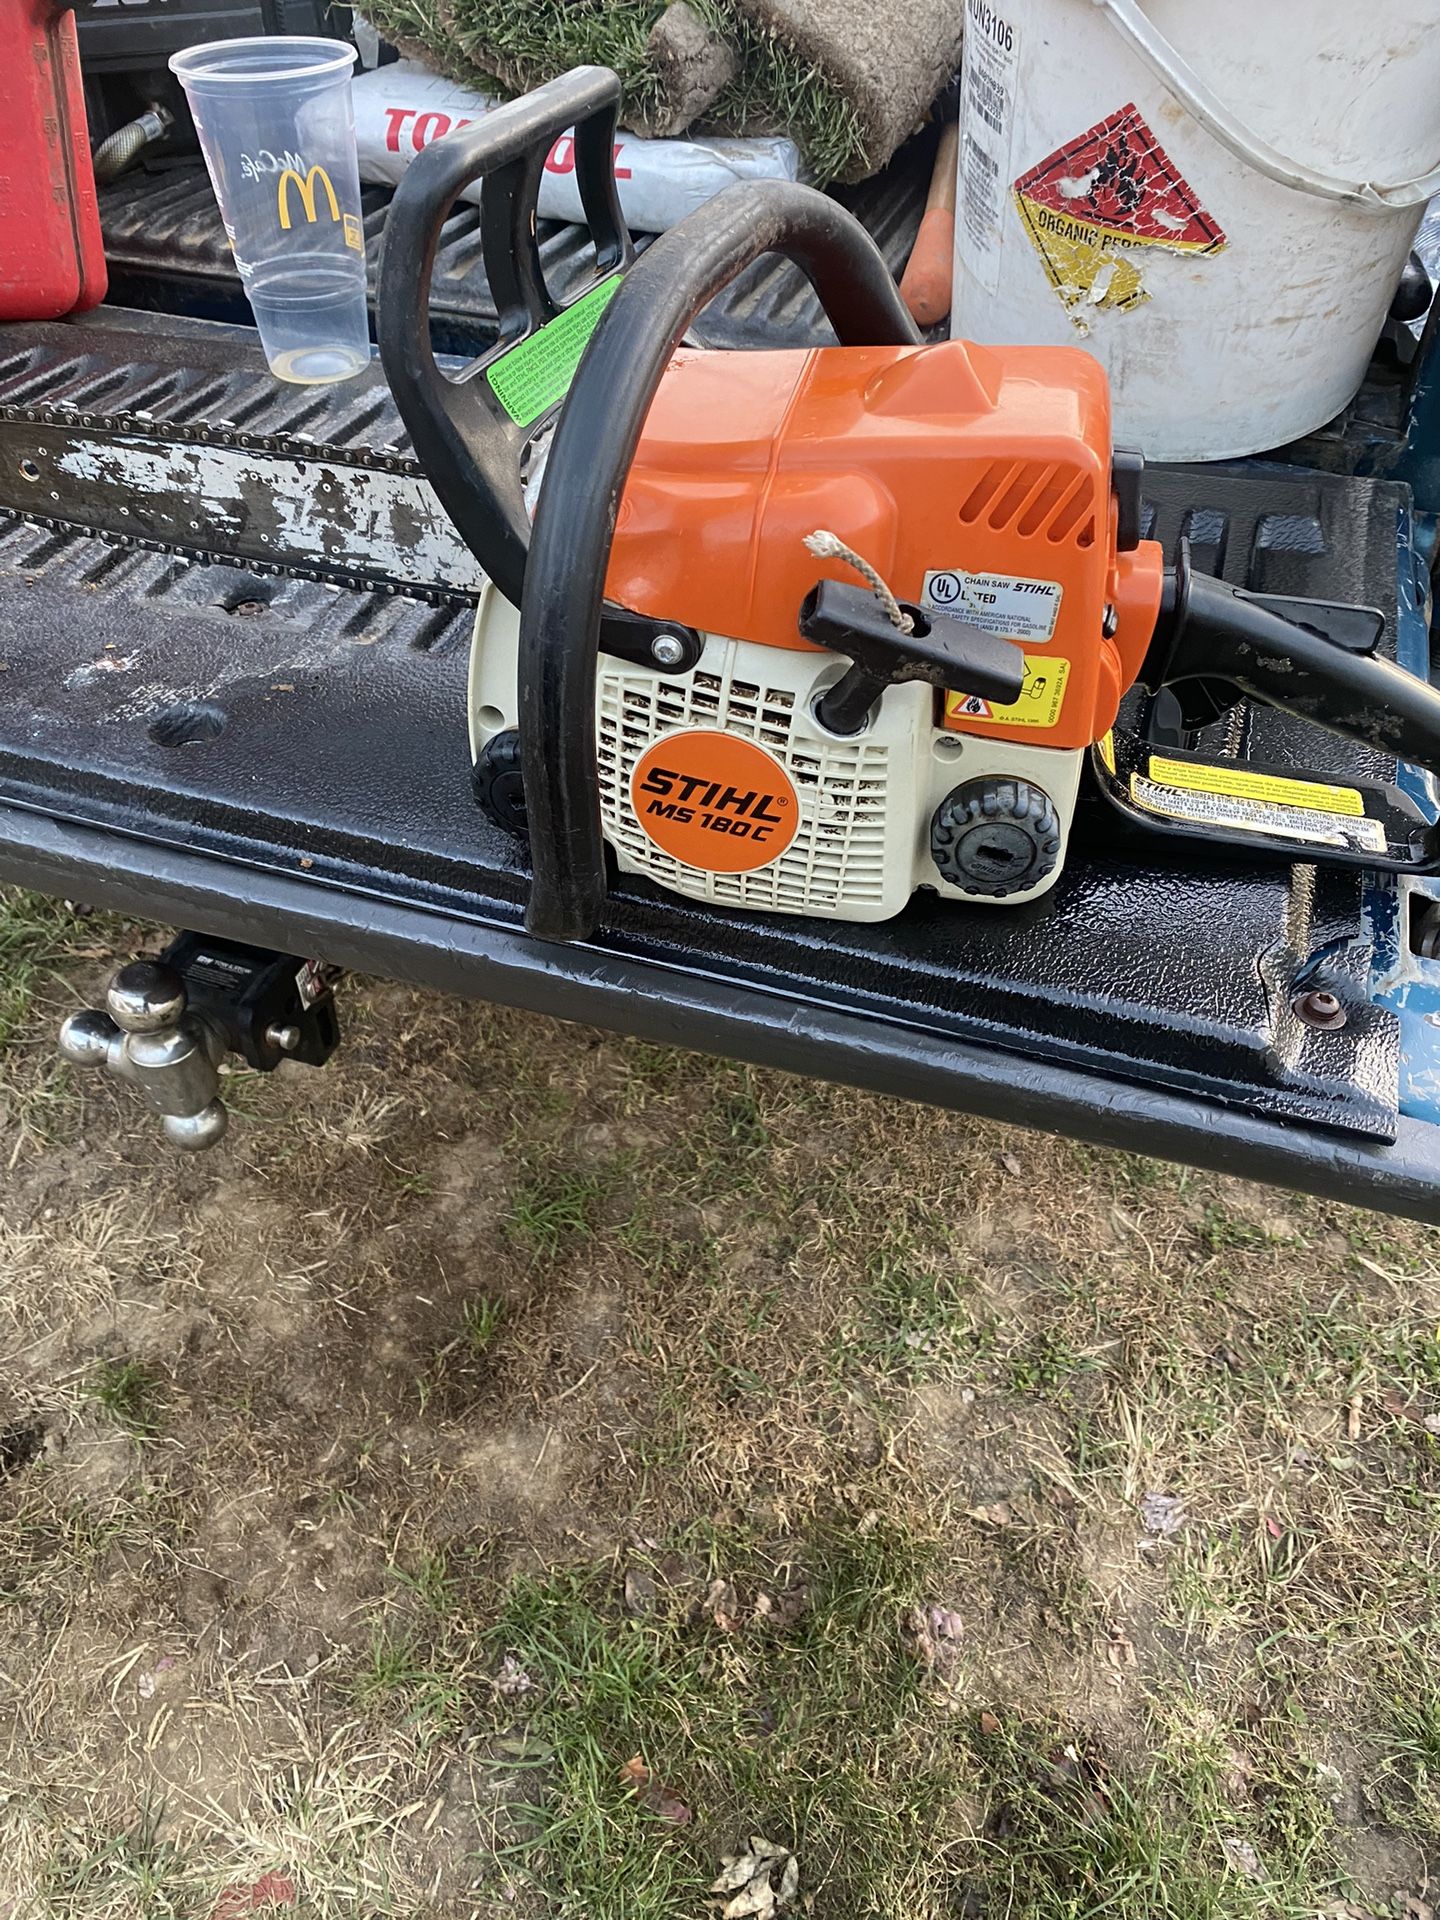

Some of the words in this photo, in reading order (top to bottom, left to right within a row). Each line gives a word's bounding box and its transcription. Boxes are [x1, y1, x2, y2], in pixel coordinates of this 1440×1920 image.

[1038, 210, 1099, 248] ORGANIC
[489, 373, 522, 424] WARNING!
[964, 576, 990, 586] CHAIN
[991, 580, 1010, 589] SAW
[930, 604, 965, 614] ACCORDANCE
[965, 608, 979, 616] WITH
[979, 610, 1005, 619] AMERICAN
[1006, 613, 1031, 622] NATIONAL
[950, 613, 969, 621] SAFETY
[970, 616, 1009, 626] SPECIFICATIONS
[1021, 622, 1047, 631] GASOLINE
[646, 799, 697, 824] MS
[1186, 789, 1215, 802] ANDREAS
[1216, 795, 1235, 805] STIHL
[1276, 805, 1305, 816] EMISSION
[1306, 810, 1334, 821] CONTROL
[1335, 815, 1376, 828] INFORMATION
